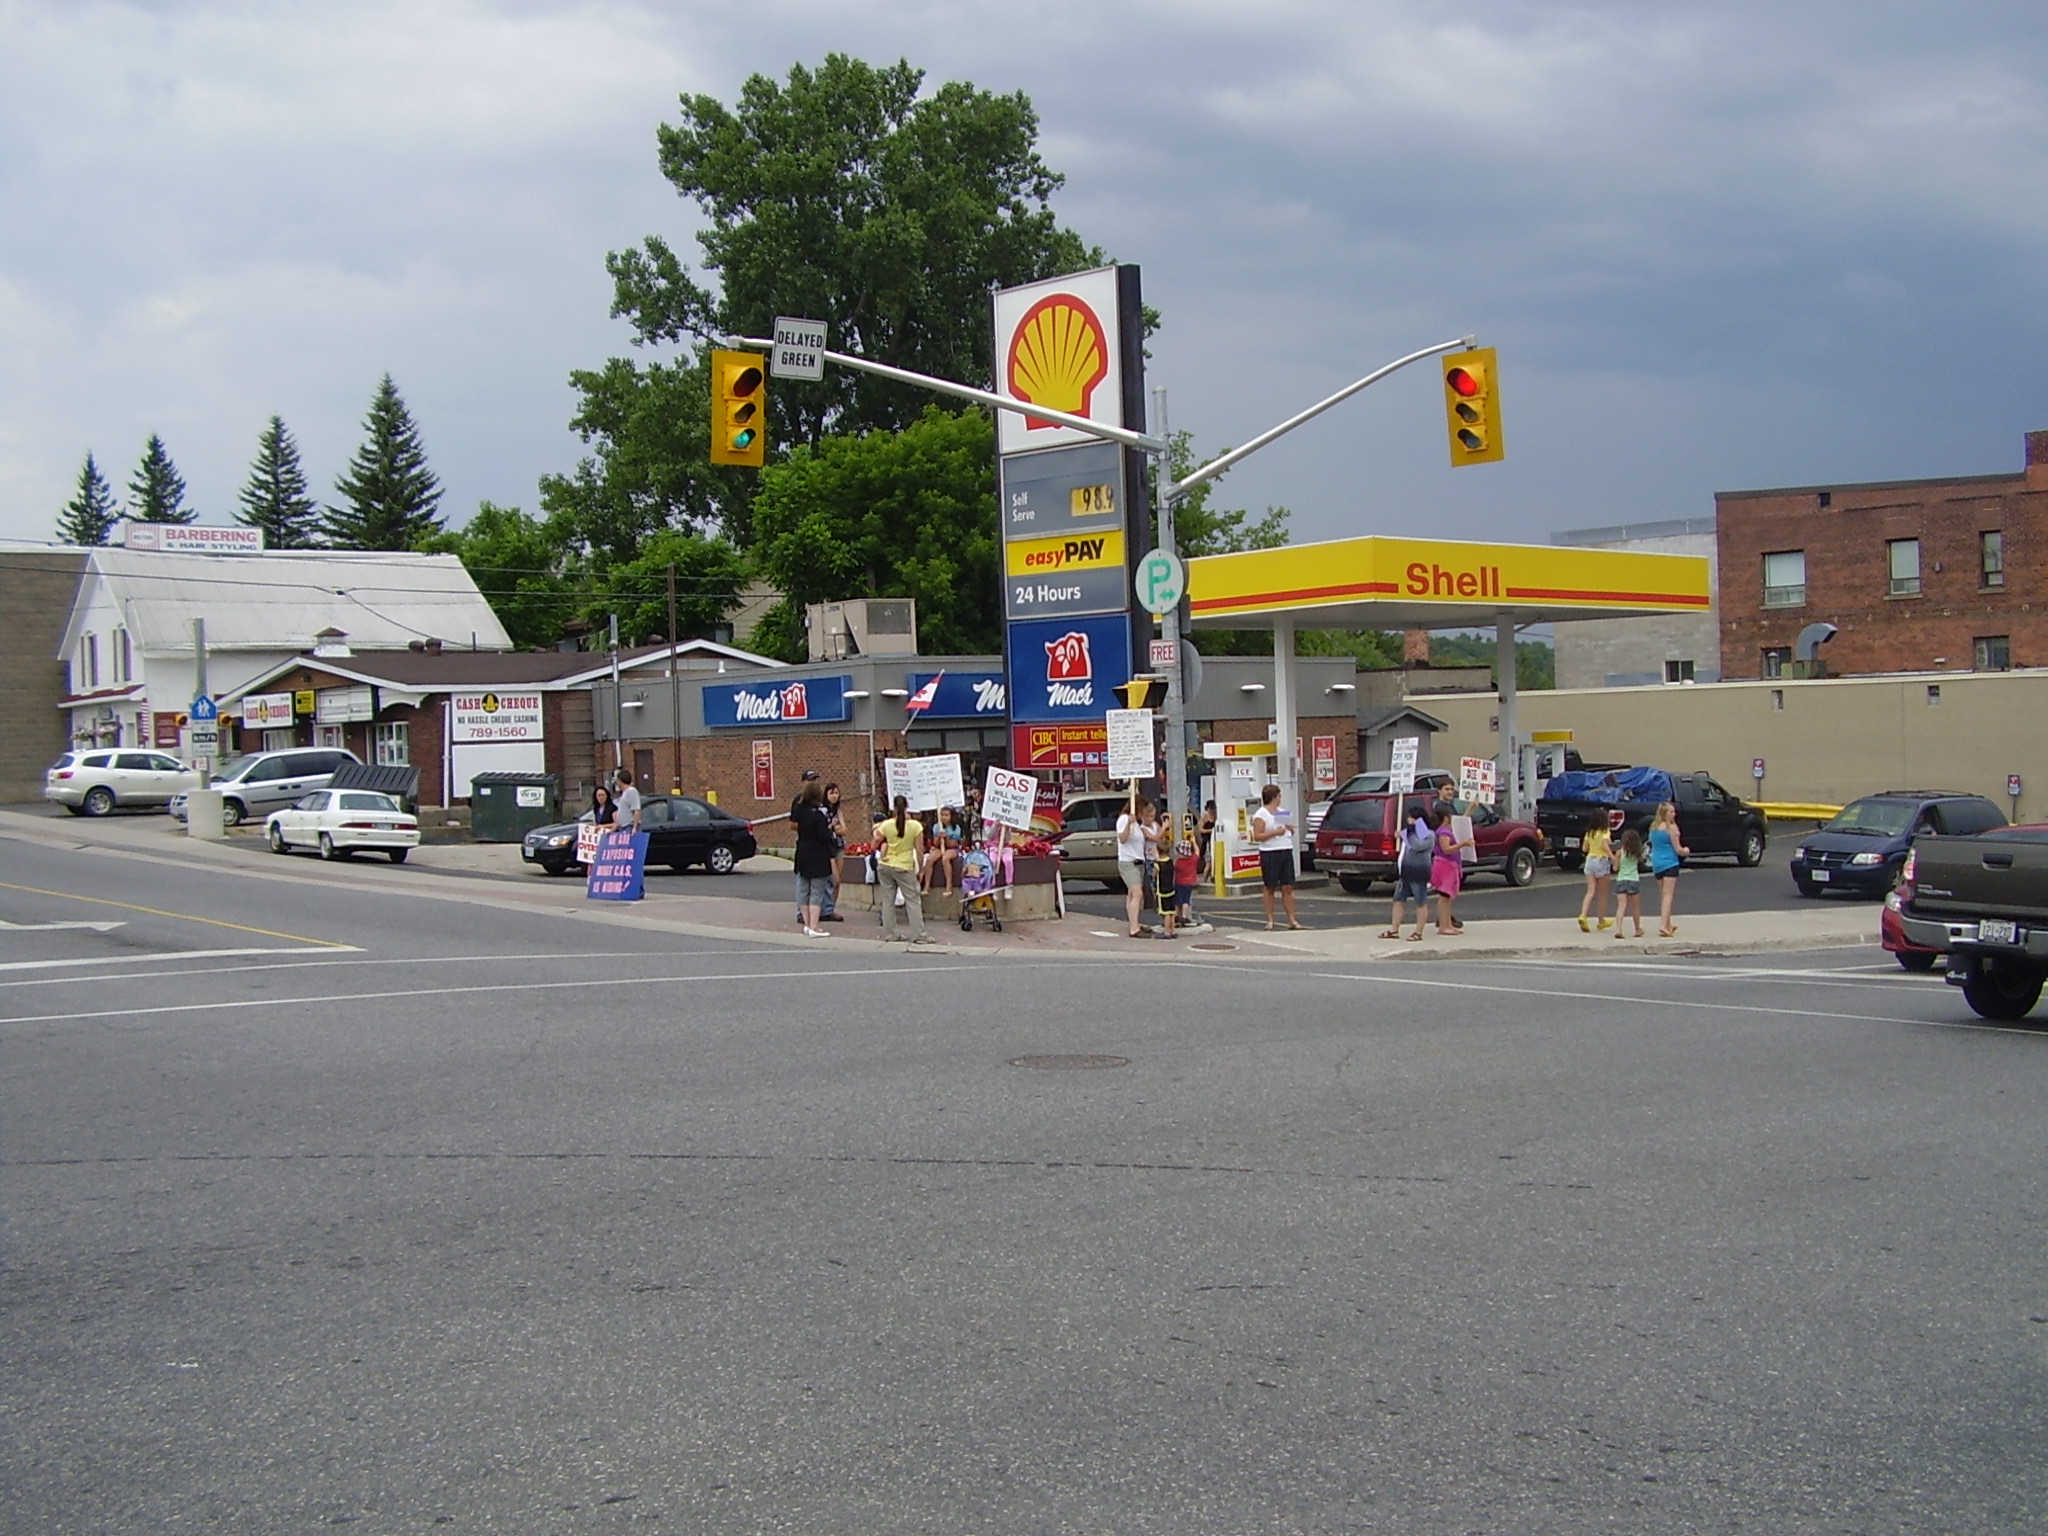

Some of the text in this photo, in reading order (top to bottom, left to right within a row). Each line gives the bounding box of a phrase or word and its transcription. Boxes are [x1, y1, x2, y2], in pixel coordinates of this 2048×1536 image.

[778, 331, 823, 348] DELAYED
[781, 351, 816, 368] GREEN
[1012, 491, 1028, 507] Self
[1082, 485, 1114, 512] 98.9
[1012, 509, 1035, 522] Serve
[165, 528, 258, 542] BARBERING
[211, 543, 258, 551] STYLING
[1025, 538, 1105, 568] easyPAY
[1148, 559, 1172, 605] P
[1406, 562, 1499, 597] Shell
[1015, 584, 1082, 604] 24 Hours
[1151, 645, 1174, 661] FREE
[1046, 681, 1094, 708] Mac's
[456, 697, 481, 710] CASH
[500, 697, 539, 709] CHEQUE
[733, 689, 780, 721] Mac's
[457, 714, 538, 724] NO HASSLE CHEQUE CASHING
[193, 734, 216, 742] km/h
[469, 726, 527, 738] 789-1560
[1032, 731, 1056, 746] CIBC
[1061, 728, 1107, 741] Instant telle
[1462, 759, 1481, 769] MORE
[994, 772, 1030, 793] CAS
[994, 789, 1025, 803] WILL NOT
[988, 796, 1001, 806] LET
[1002, 799, 1013, 808] ME
[1014, 802, 1028, 812] SEE
[1001, 807, 1011, 815] MY
[991, 812, 1019, 826] FRIENDS
[602, 848, 635, 860] EXPOSING
